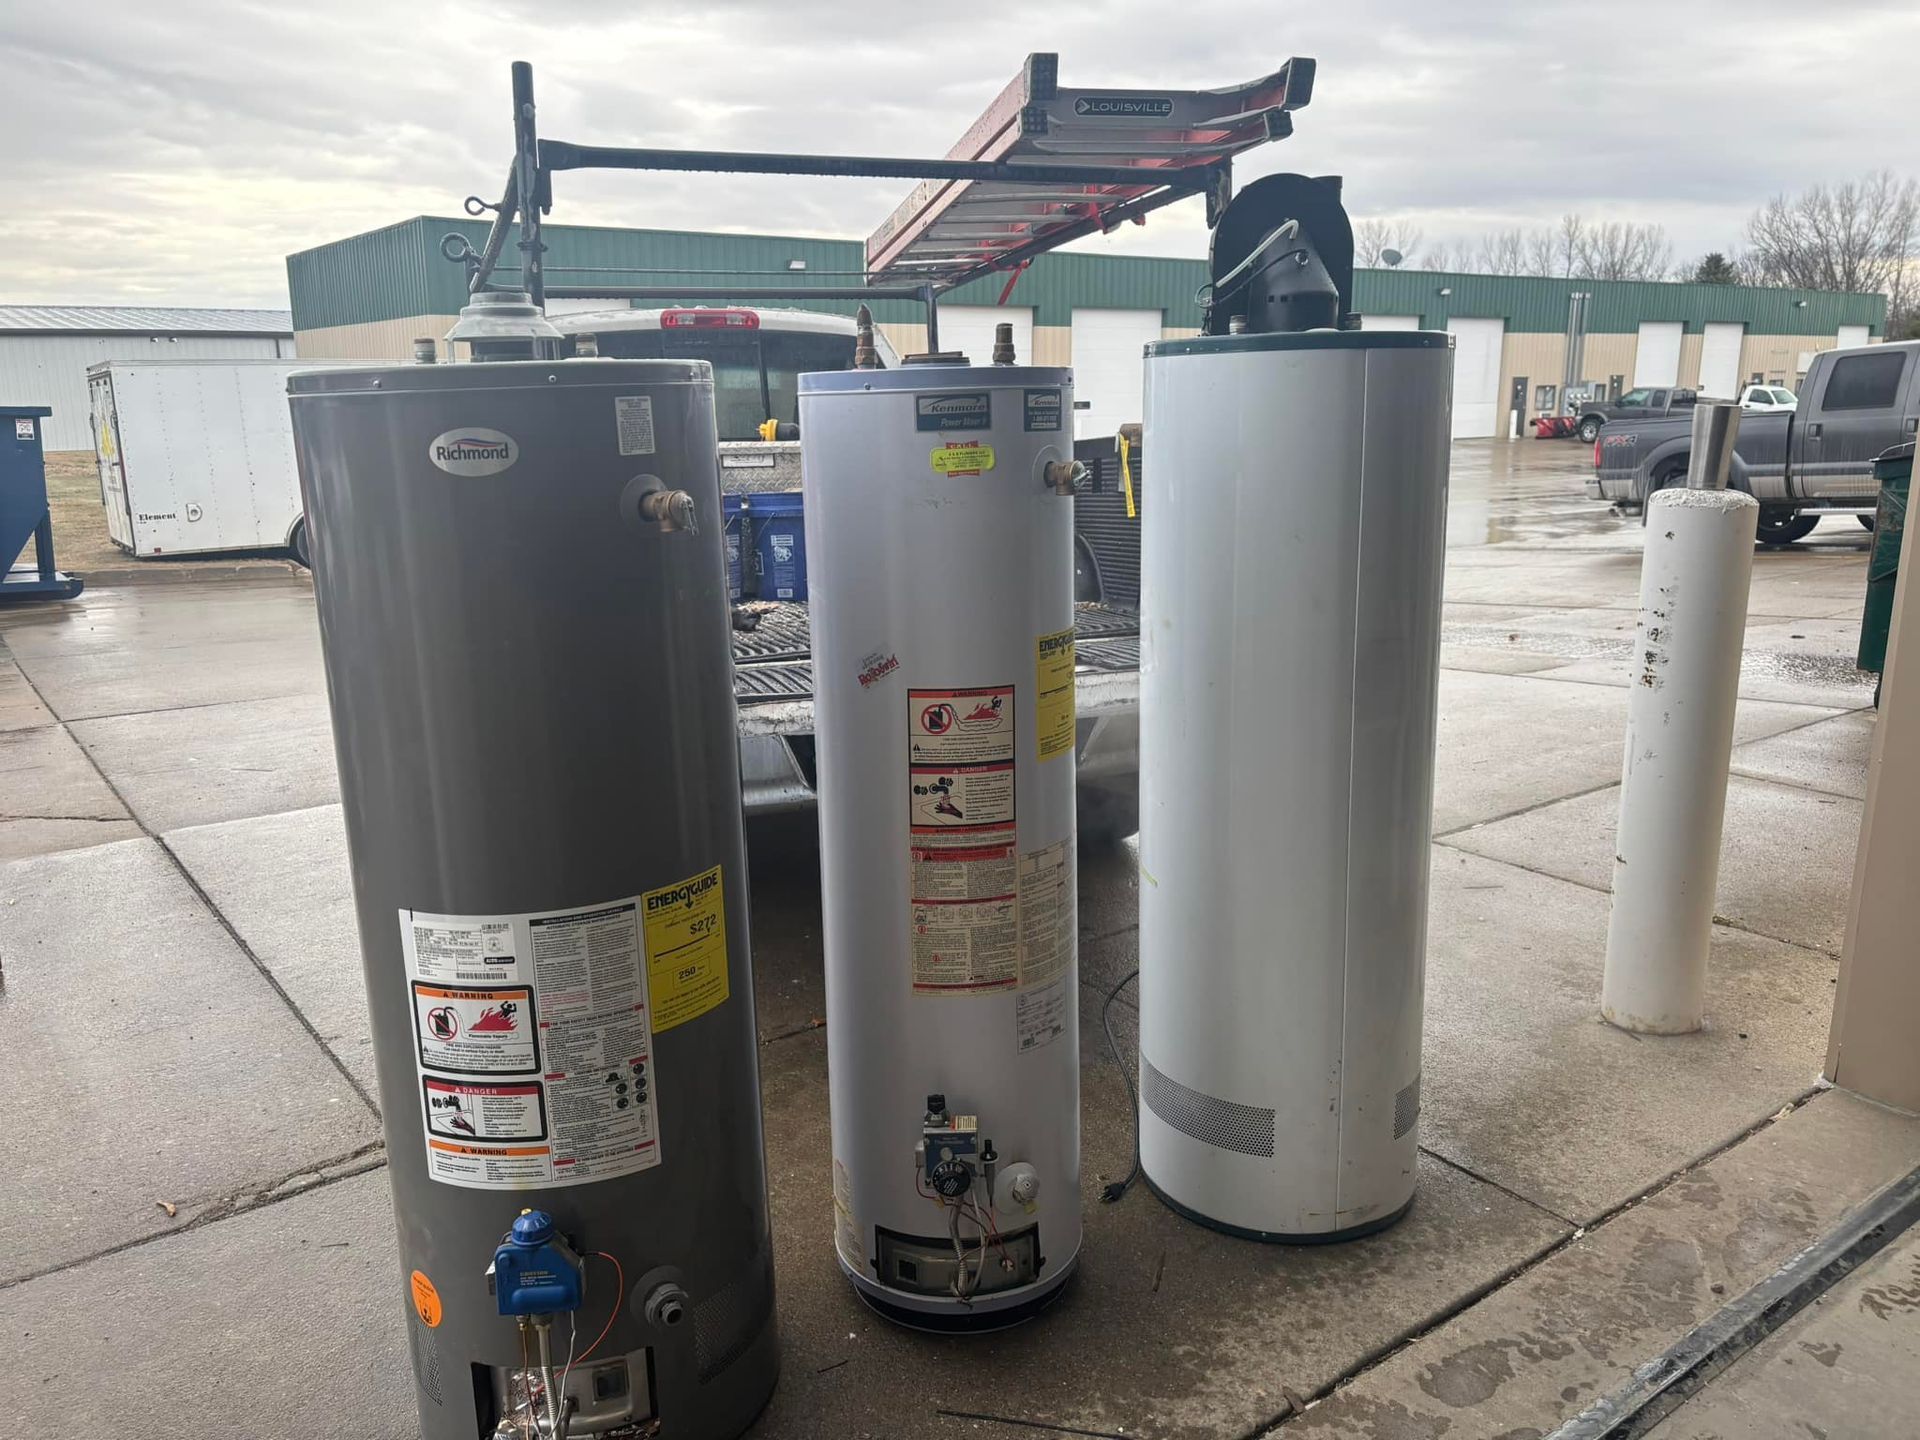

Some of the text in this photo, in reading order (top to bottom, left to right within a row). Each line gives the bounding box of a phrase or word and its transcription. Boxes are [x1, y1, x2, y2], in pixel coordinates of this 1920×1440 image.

[1091, 102, 1170, 113] LOUISVILLE
[931, 403, 985, 413] Kenmore
[436, 442, 510, 462] Richmond
[139, 513, 176, 521] Element
[647, 873, 718, 911] ENERGYGUIDE
[678, 966, 696, 979] 250
[451, 991, 494, 1000] WARNING
[463, 1086, 497, 1095] DANGER
[471, 1148, 508, 1156] WARNING
